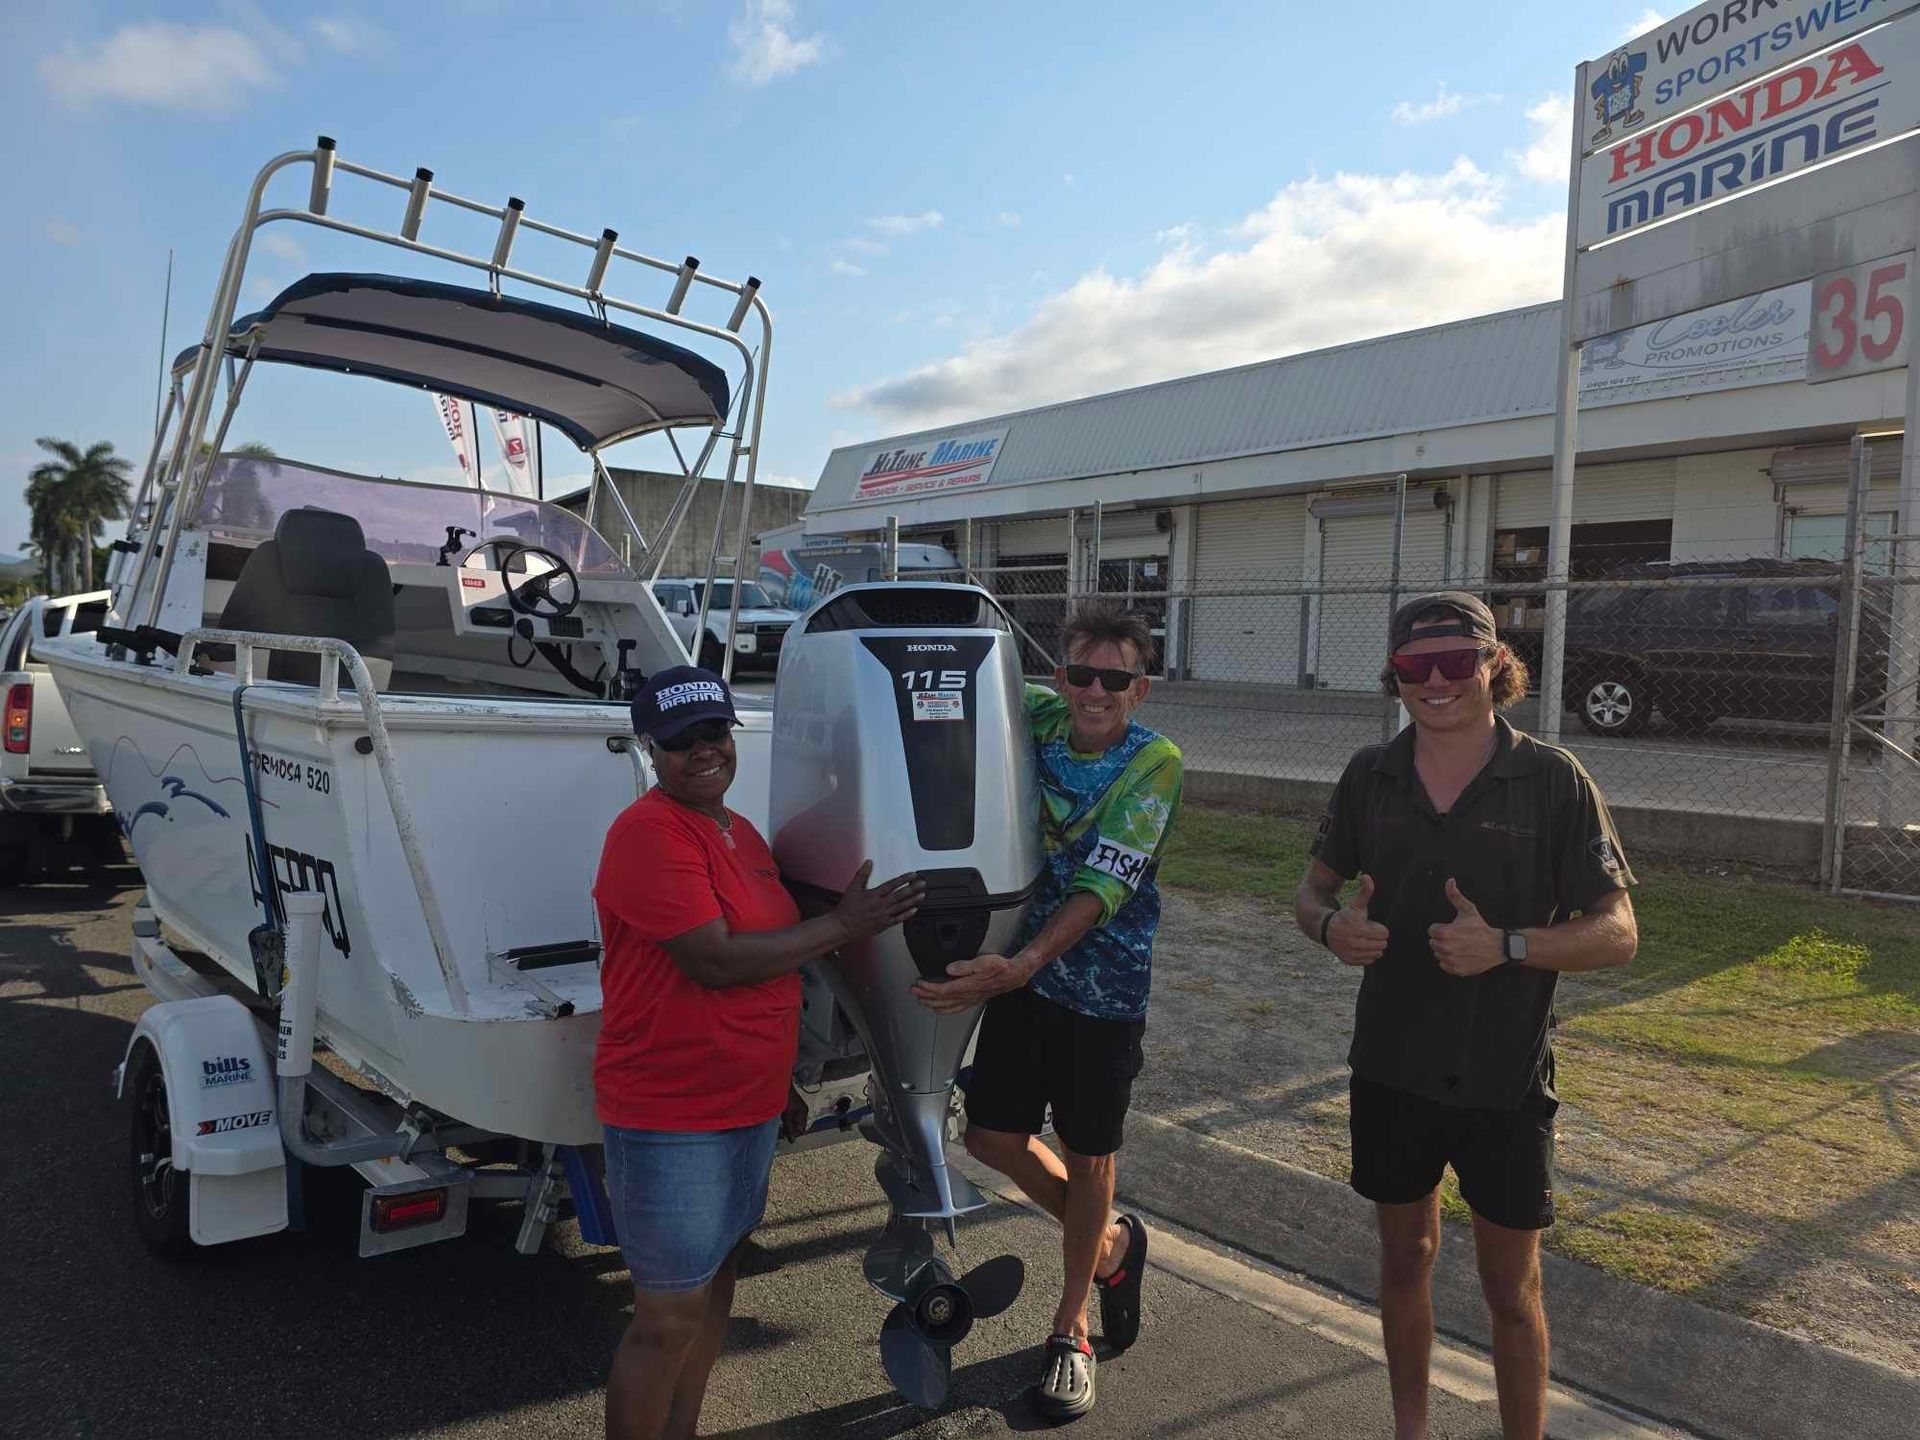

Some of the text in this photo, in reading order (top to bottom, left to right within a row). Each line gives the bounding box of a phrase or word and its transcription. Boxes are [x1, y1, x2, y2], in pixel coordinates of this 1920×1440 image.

[1656, 0, 1780, 63] WORK
[1654, 0, 1887, 105] SPORTSWE
[1608, 42, 1885, 184] HONDA
[1607, 98, 1880, 234] MARINE
[1815, 263, 1907, 370] 35
[1643, 332, 1784, 365] PROMOTIONS
[907, 644, 958, 652] HONDA
[655, 681, 723, 699] HONDA
[901, 669, 967, 690] 115
[659, 692, 725, 712] MARINE
[306, 766, 330, 795] 520
[1092, 843, 1149, 884] FISH
[202, 1056, 251, 1075] bills
[205, 1071, 252, 1086] MARINE
[215, 1111, 271, 1132] MOVE
